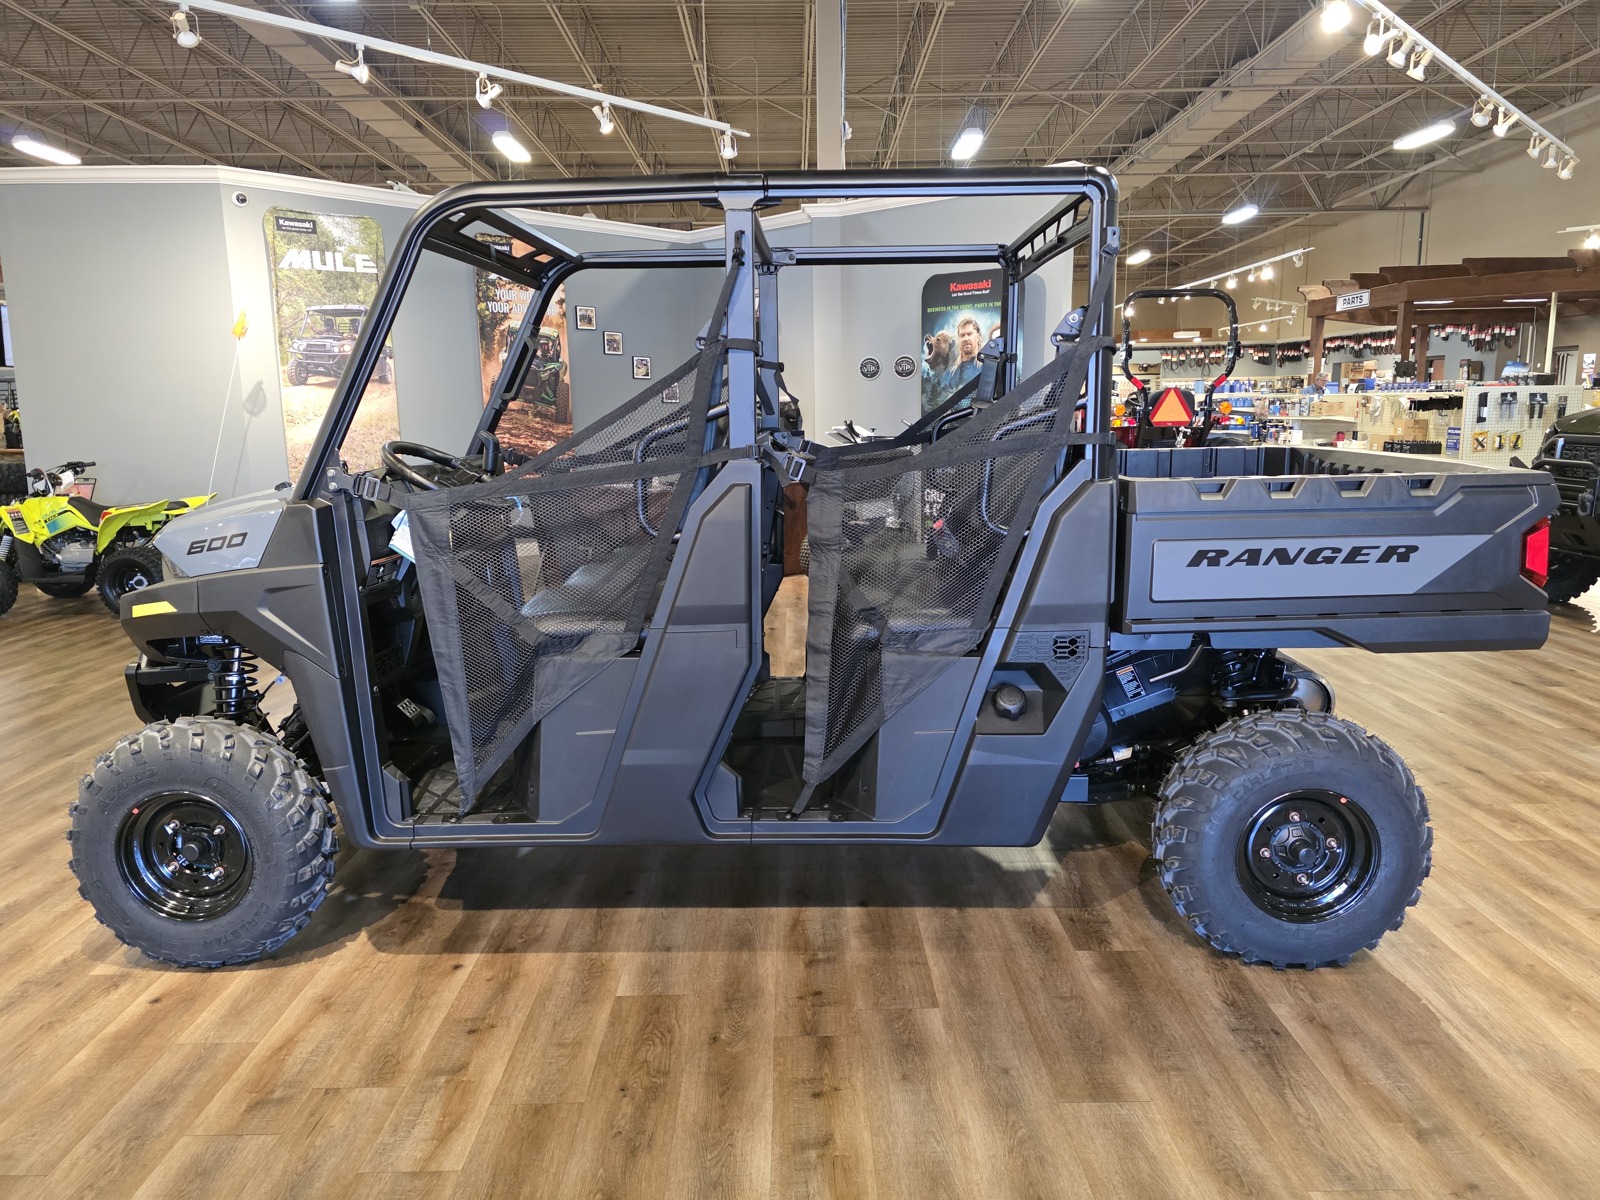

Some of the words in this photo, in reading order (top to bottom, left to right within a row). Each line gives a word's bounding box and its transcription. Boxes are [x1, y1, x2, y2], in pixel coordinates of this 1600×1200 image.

[278, 219, 313, 228] Kawasaki
[278, 248, 379, 274] MULE
[950, 279, 991, 291] Kawasaki
[495, 288, 518, 300] YOUR
[1343, 295, 1364, 306] PARTS
[487, 301, 510, 314] YOUR
[186, 532, 248, 555] 600
[1186, 545, 1420, 568] RANGER
